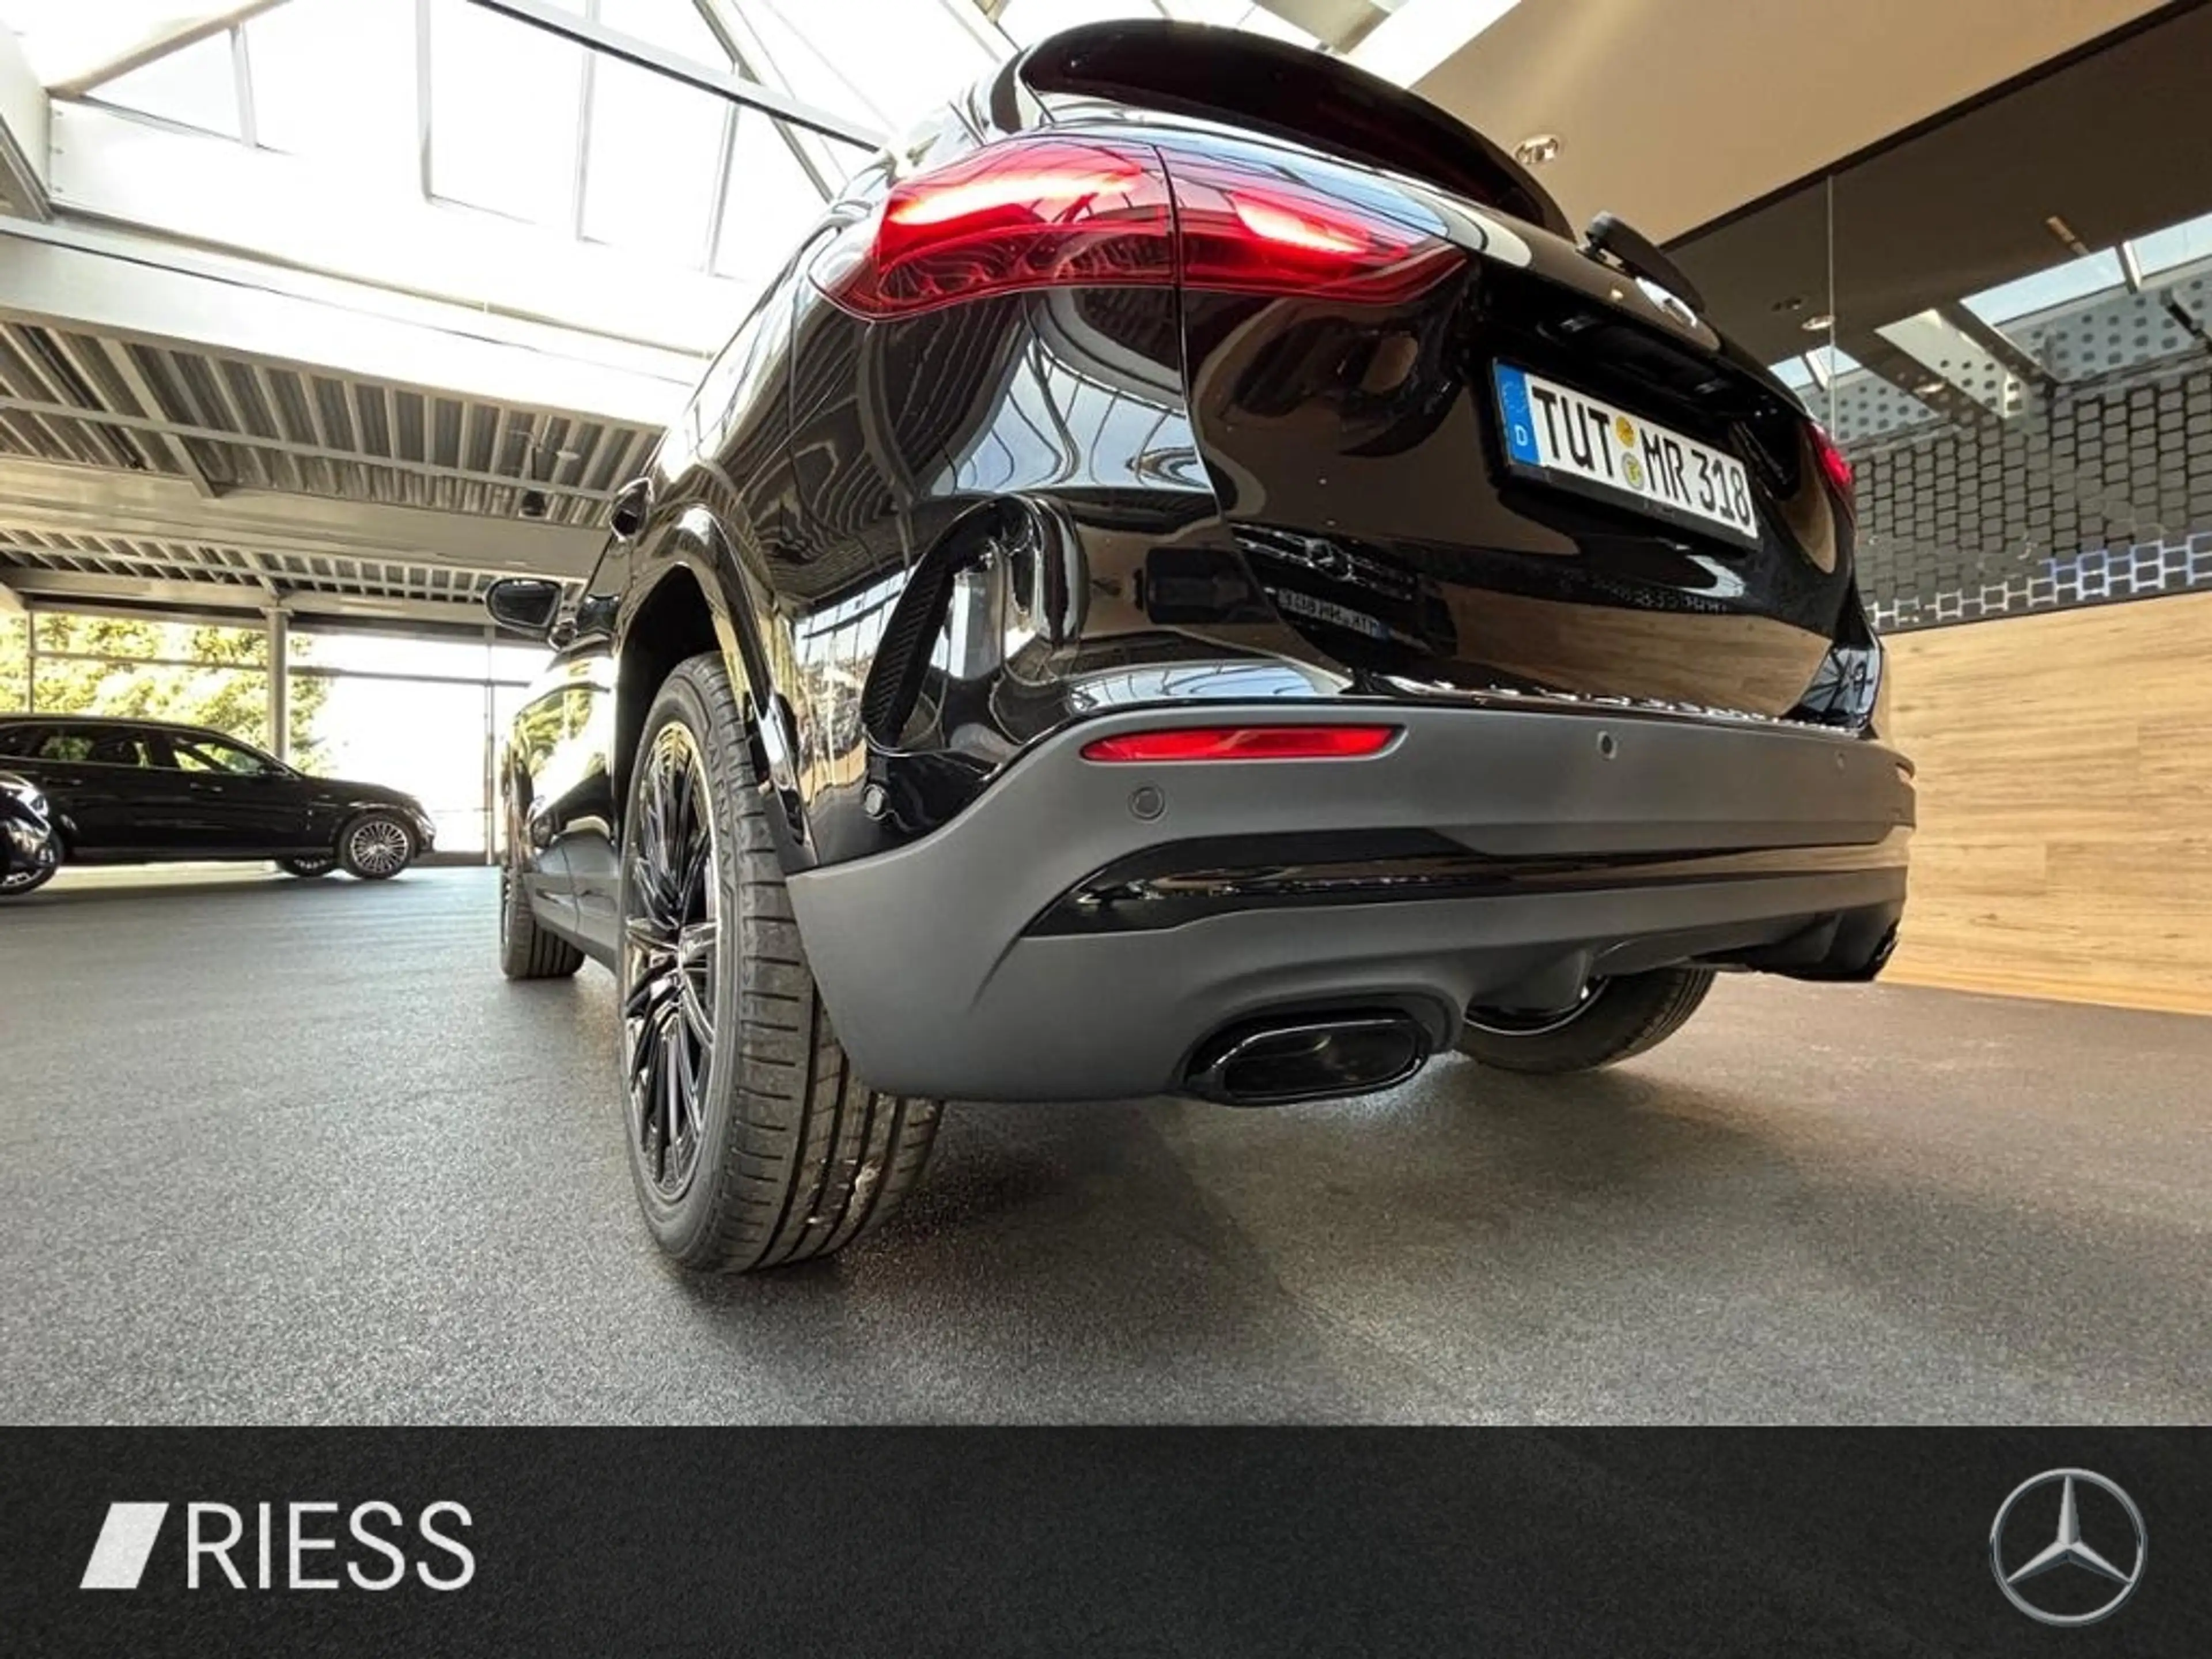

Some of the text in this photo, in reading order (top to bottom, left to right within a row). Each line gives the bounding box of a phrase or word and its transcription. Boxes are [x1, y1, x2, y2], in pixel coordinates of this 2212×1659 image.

[1514, 423, 1529, 446] D
[1531, 385, 1751, 527] TUT MR 318
